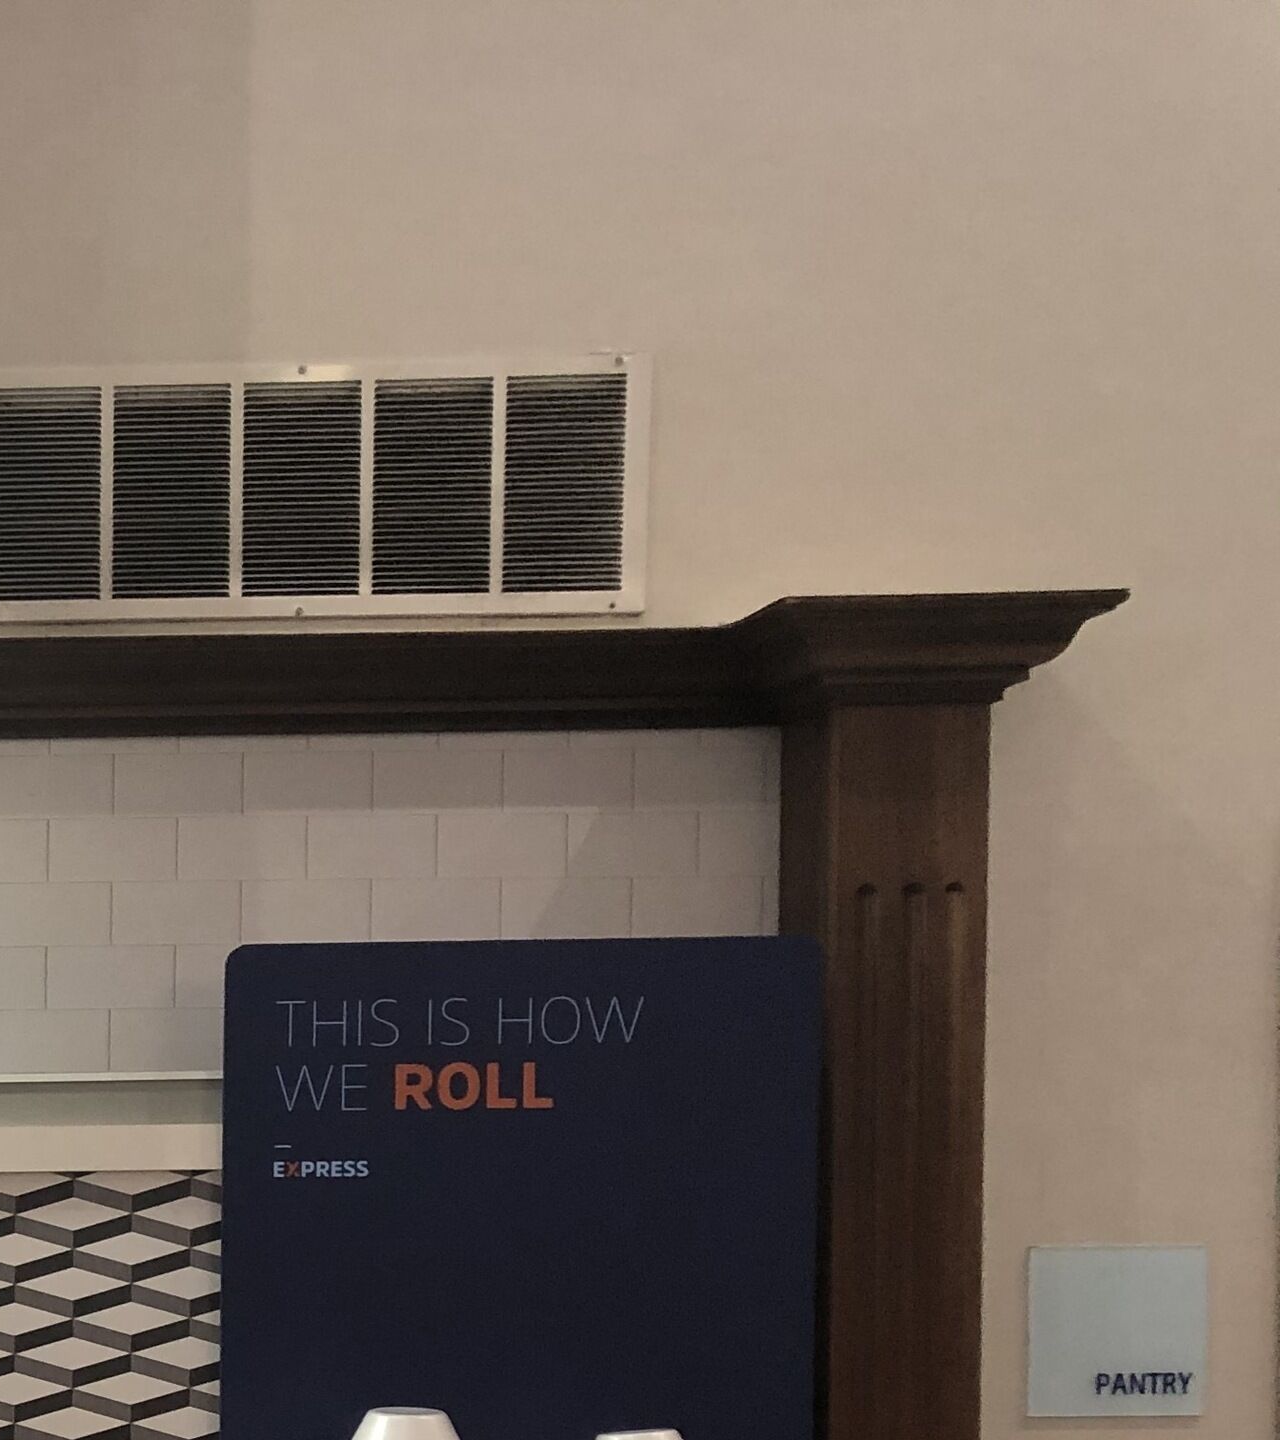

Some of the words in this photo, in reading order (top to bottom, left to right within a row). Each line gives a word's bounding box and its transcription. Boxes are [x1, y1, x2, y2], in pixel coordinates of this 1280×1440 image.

[275, 998, 400, 1048] THIS
[427, 997, 471, 1047] IS
[497, 995, 645, 1045] HOW
[275, 1063, 369, 1113] WE
[392, 1061, 555, 1112] ROLL
[272, 1159, 370, 1179] EXPRESS
[1094, 1371, 1194, 1395] PANTRY
